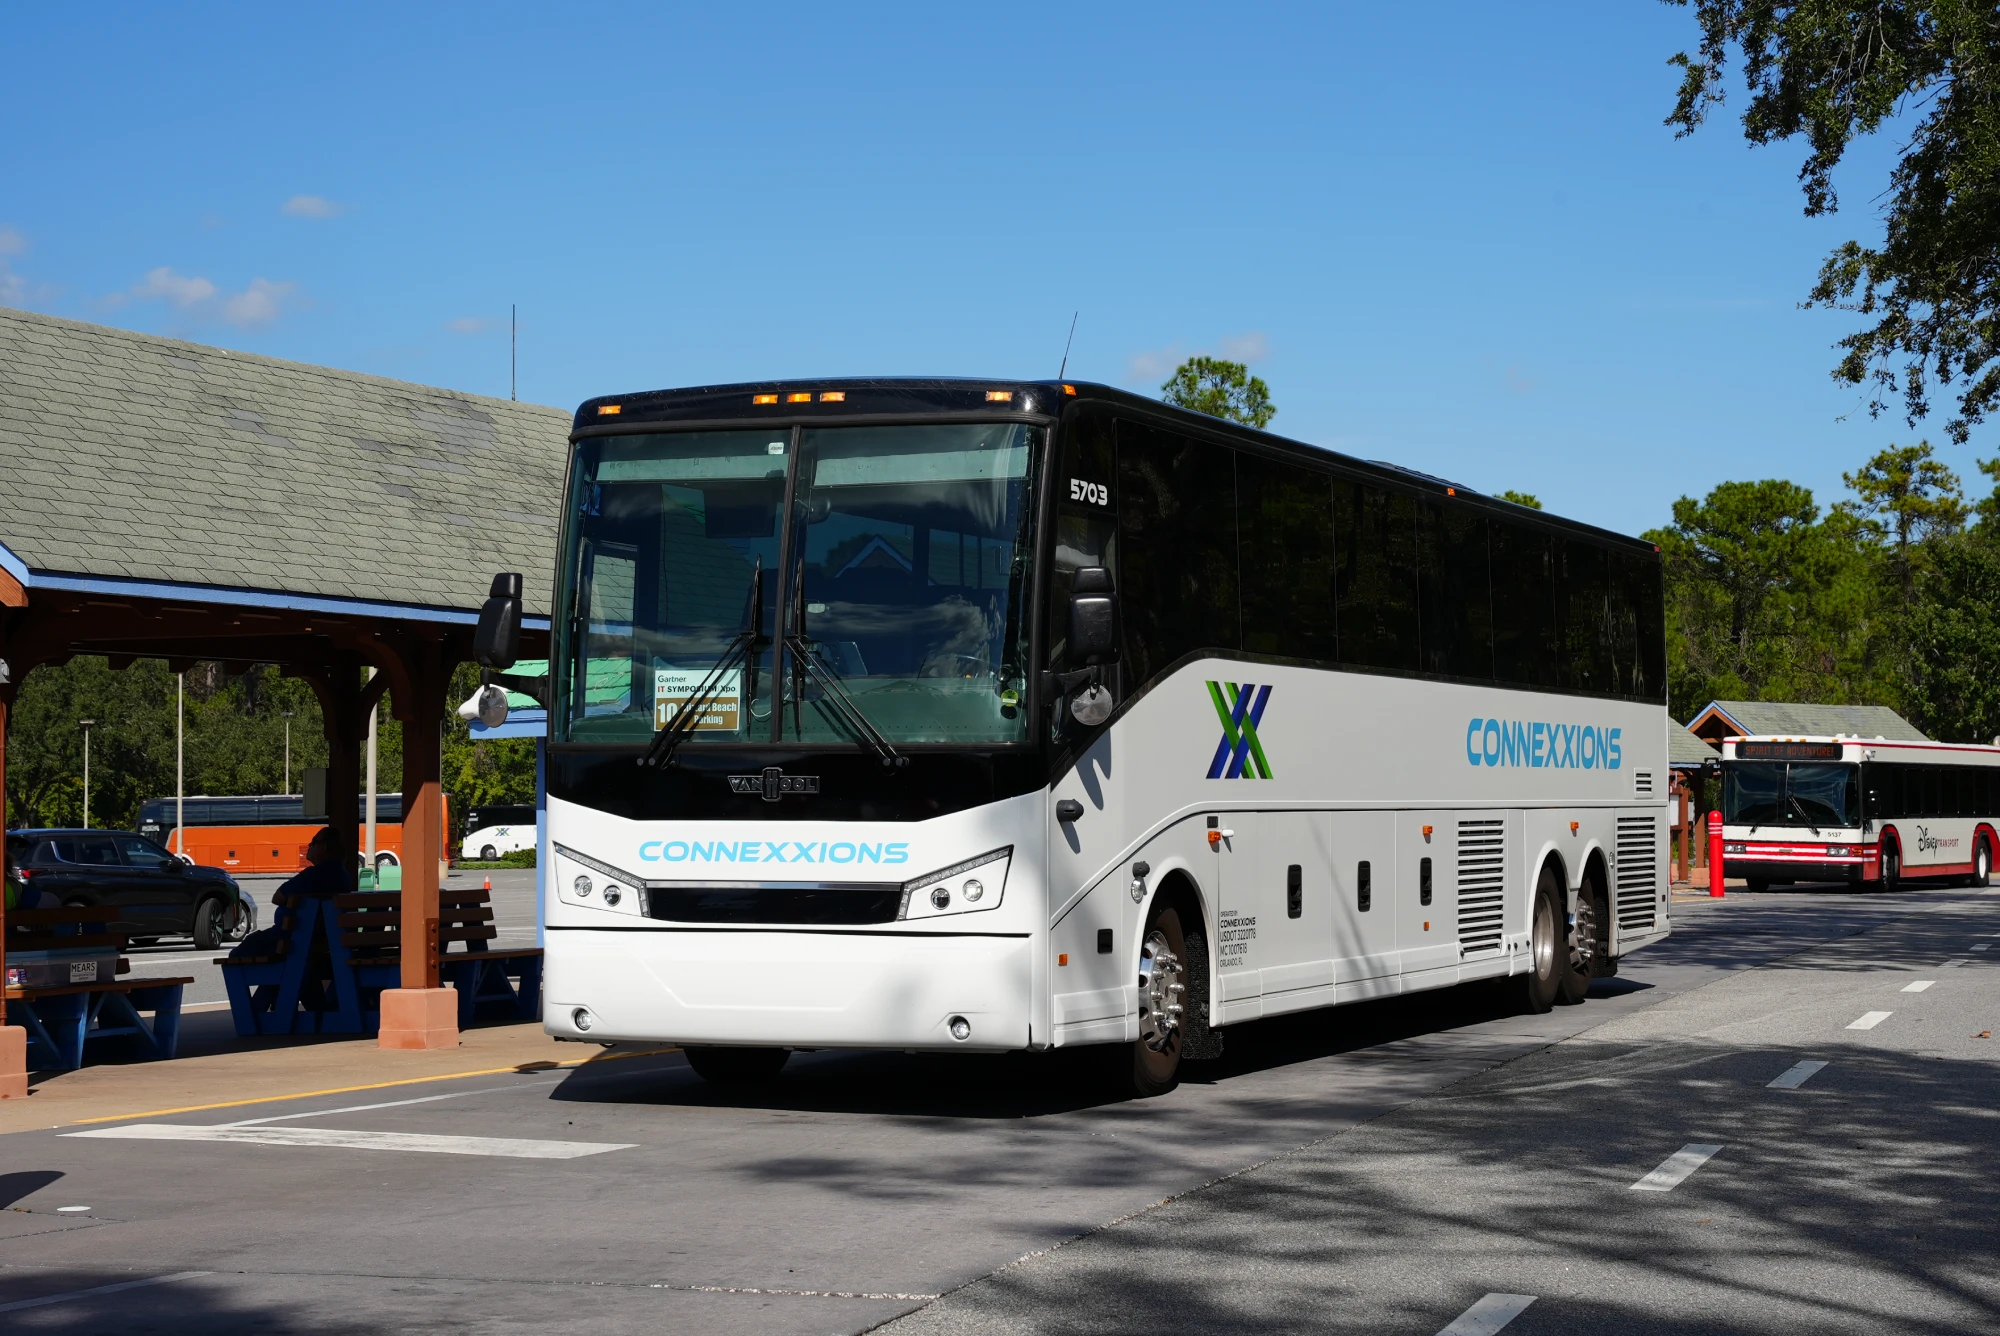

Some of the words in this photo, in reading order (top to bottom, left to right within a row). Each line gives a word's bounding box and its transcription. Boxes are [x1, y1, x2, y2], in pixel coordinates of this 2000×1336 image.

[1071, 478, 1107, 506] 5703
[657, 703, 678, 723] 10
[712, 703, 736, 712] Beach
[1467, 718, 1621, 769] CONNEXXIONS
[1746, 745, 1771, 756] SPIRIT
[1774, 745, 1784, 756] OF
[1787, 745, 1834, 757] ADVENTURE!
[639, 841, 910, 864] CONNEXXIONS
[1220, 917, 1256, 928] CONNEXXIONS
[1220, 930, 1237, 942] USDOT
[1220, 944, 1228, 956] MC
[72, 962, 96, 972] MEARS
